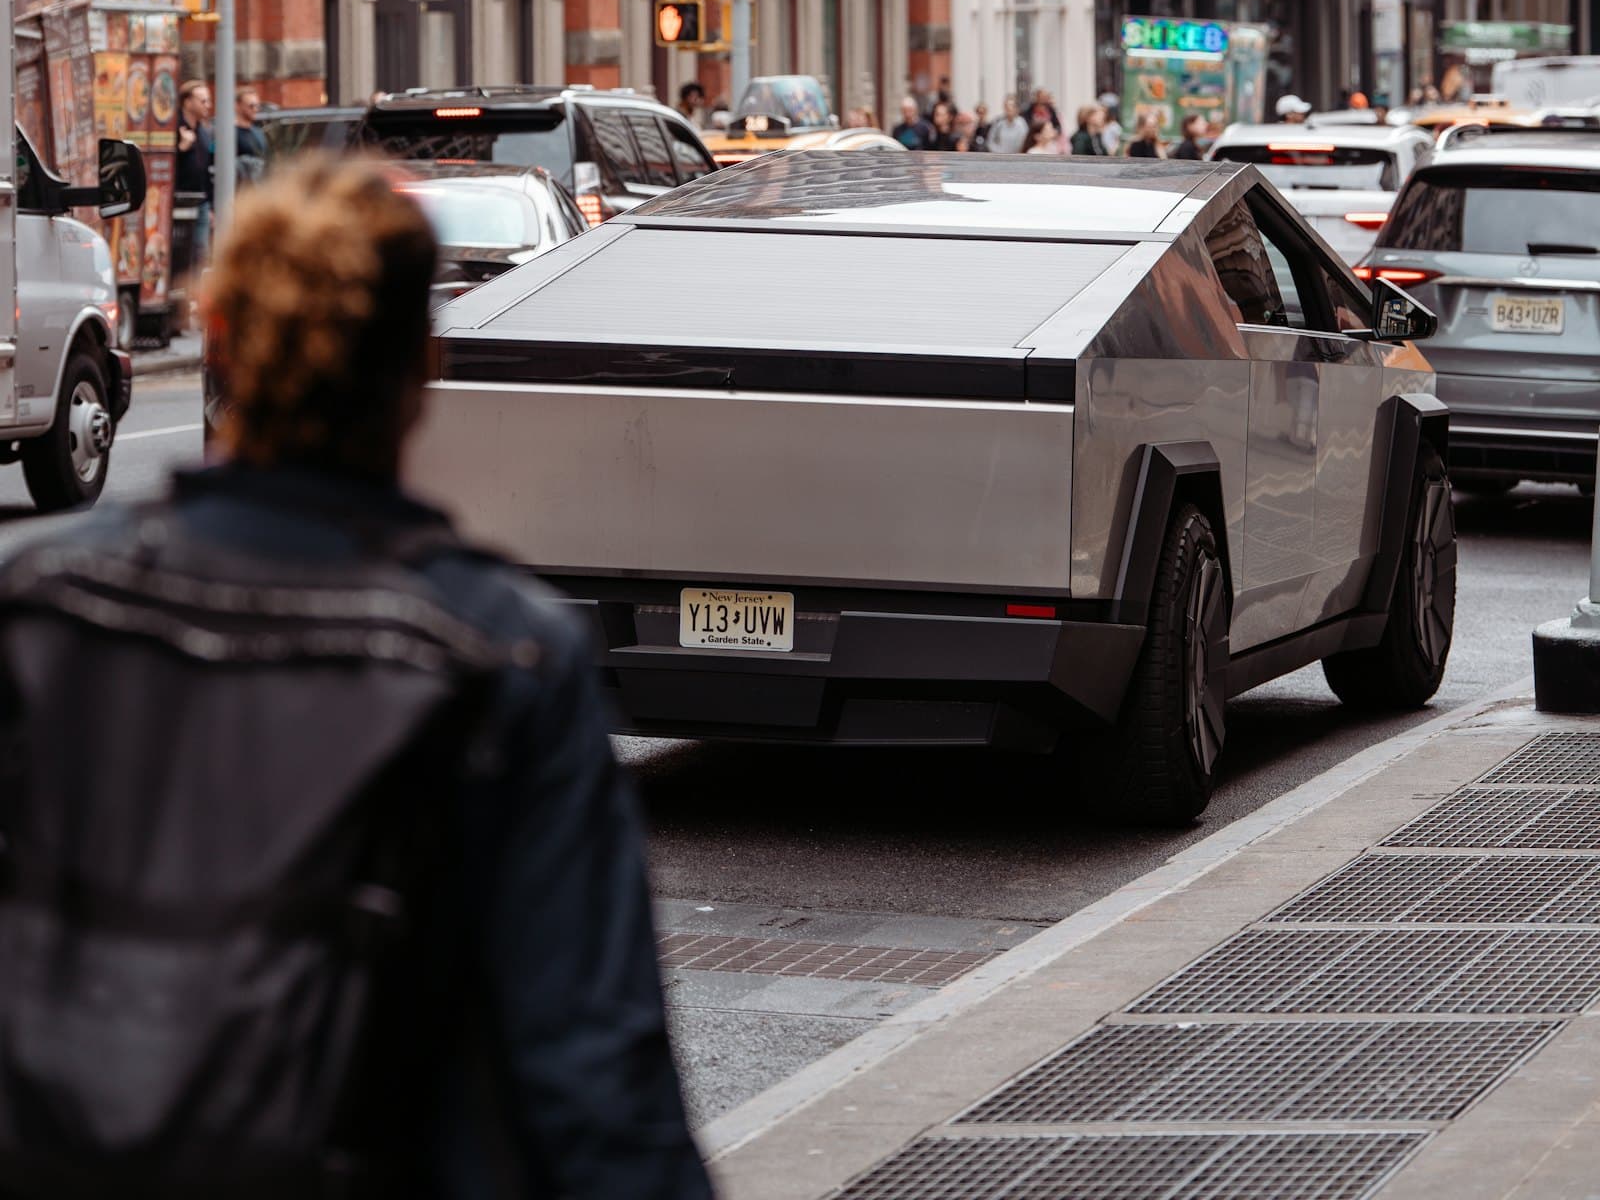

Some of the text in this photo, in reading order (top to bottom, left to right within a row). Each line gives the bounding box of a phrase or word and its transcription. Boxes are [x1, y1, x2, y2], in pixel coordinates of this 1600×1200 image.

[709, 592, 766, 605] New Jersey
[708, 635, 766, 646] Garden State
